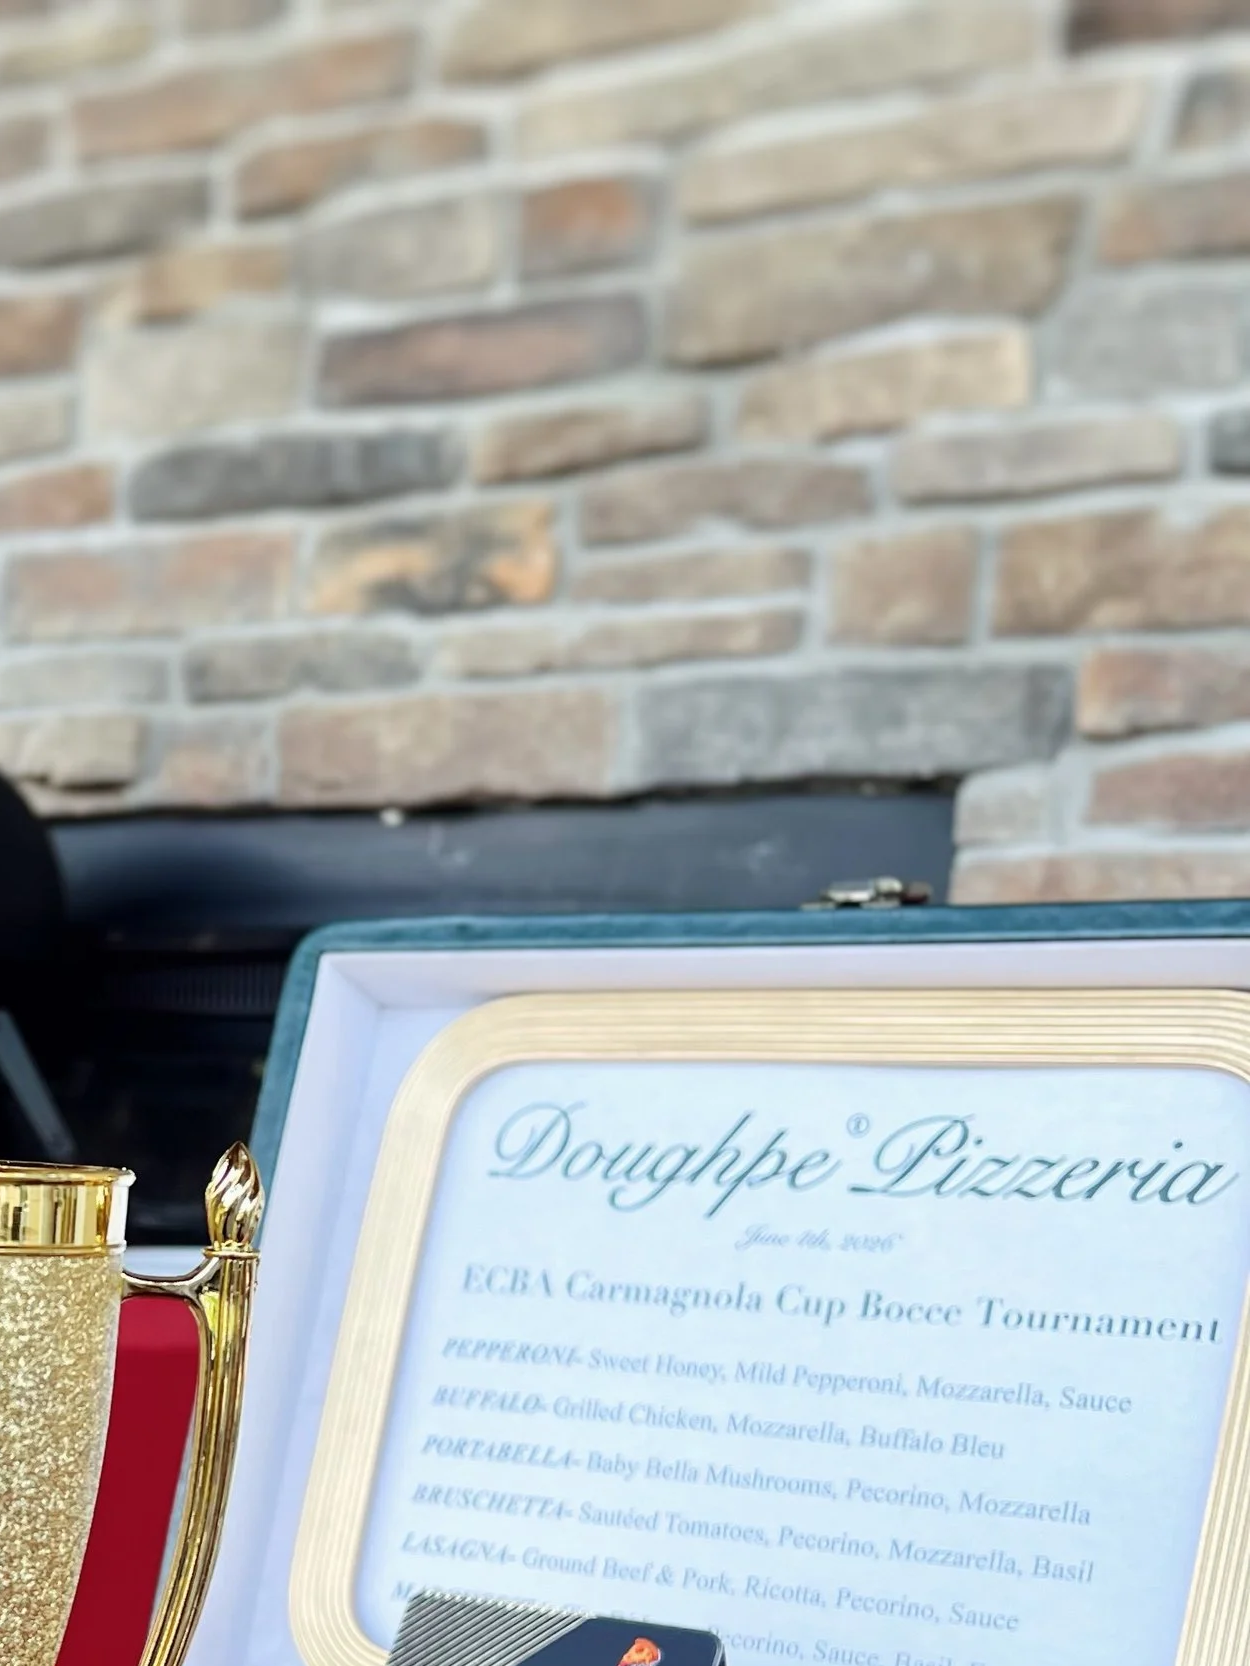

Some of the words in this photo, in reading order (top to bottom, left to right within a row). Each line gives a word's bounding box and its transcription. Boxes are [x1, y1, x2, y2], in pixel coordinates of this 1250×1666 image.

[846, 1113, 1240, 1205] Pizzeria
[735, 1224, 790, 1251] June
[462, 1262, 554, 1298] ECBA
[566, 1269, 763, 1317] Carmagnola
[776, 1284, 846, 1327] Cup
[859, 1289, 962, 1327] Bocce
[977, 1297, 1222, 1344] Tournament
[588, 1349, 648, 1374] Sweet
[655, 1354, 726, 1384] Honey,
[735, 1360, 785, 1385] Mild
[792, 1365, 908, 1397] Pepperoni,
[916, 1375, 1051, 1410] Mozzarella,
[1059, 1386, 1132, 1414] Sauce
[552, 1396, 622, 1423] Grilled
[629, 1403, 719, 1434] Chicken,
[726, 1414, 850, 1447] Mozzarella,
[859, 1424, 944, 1454] Buffalo
[950, 1434, 1005, 1460] Bleu
[587, 1450, 640, 1478] Baby
[645, 1456, 698, 1483] Bella
[704, 1463, 838, 1500] Mushrooms,
[845, 1478, 951, 1513] Pecorino,
[958, 1491, 1091, 1526] Mozzarella
[578, 1500, 658, 1531] Sautéed
[665, 1511, 771, 1547] Tomatoes,
[777, 1525, 881, 1561] Pecorino,
[888, 1538, 1022, 1579] Mozzarella,
[1031, 1555, 1095, 1584] Basil
[522, 1550, 596, 1576] Ground
[602, 1558, 652, 1583] Beef
[655, 1566, 676, 1587] &
[681, 1567, 736, 1597] Pork,
[745, 1576, 827, 1608] Ricotta,
[836, 1587, 940, 1624] Pecorino,
[948, 1603, 1020, 1632] Sauce
